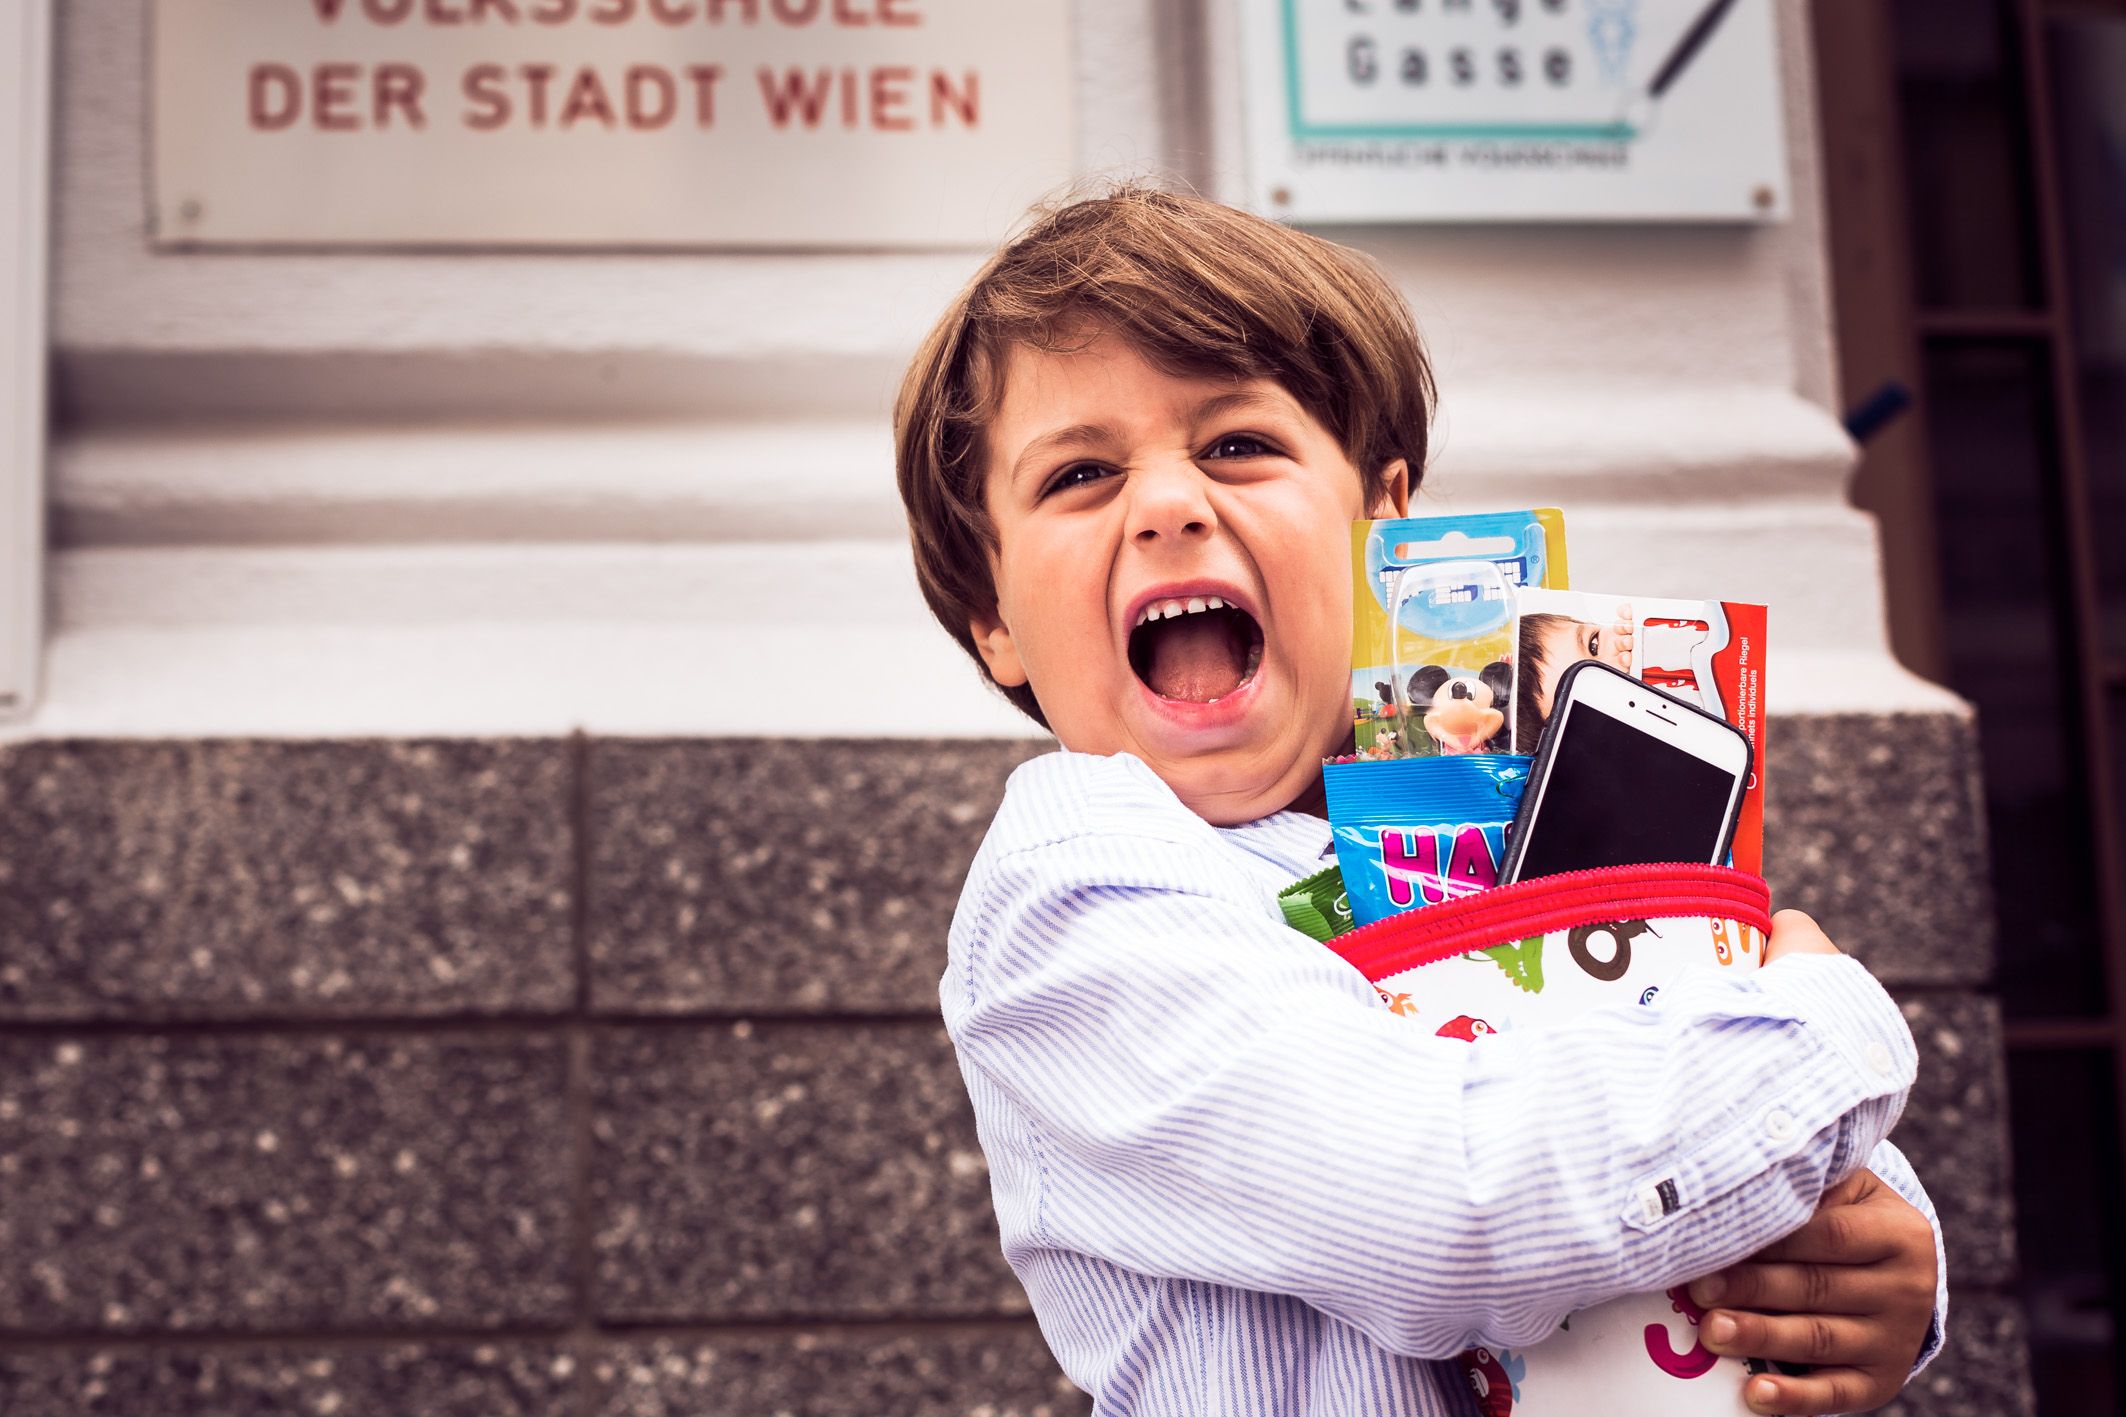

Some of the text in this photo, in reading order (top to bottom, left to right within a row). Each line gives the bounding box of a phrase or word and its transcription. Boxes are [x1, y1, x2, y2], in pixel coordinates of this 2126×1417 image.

[1346, 36, 1574, 86] Gasse
[247, 63, 983, 132] DER STADT WIEN
[1737, 636, 1750, 730] portionierbare Riegel
[1747, 669, 1758, 718] individuels
[1378, 822, 1514, 907] HA
